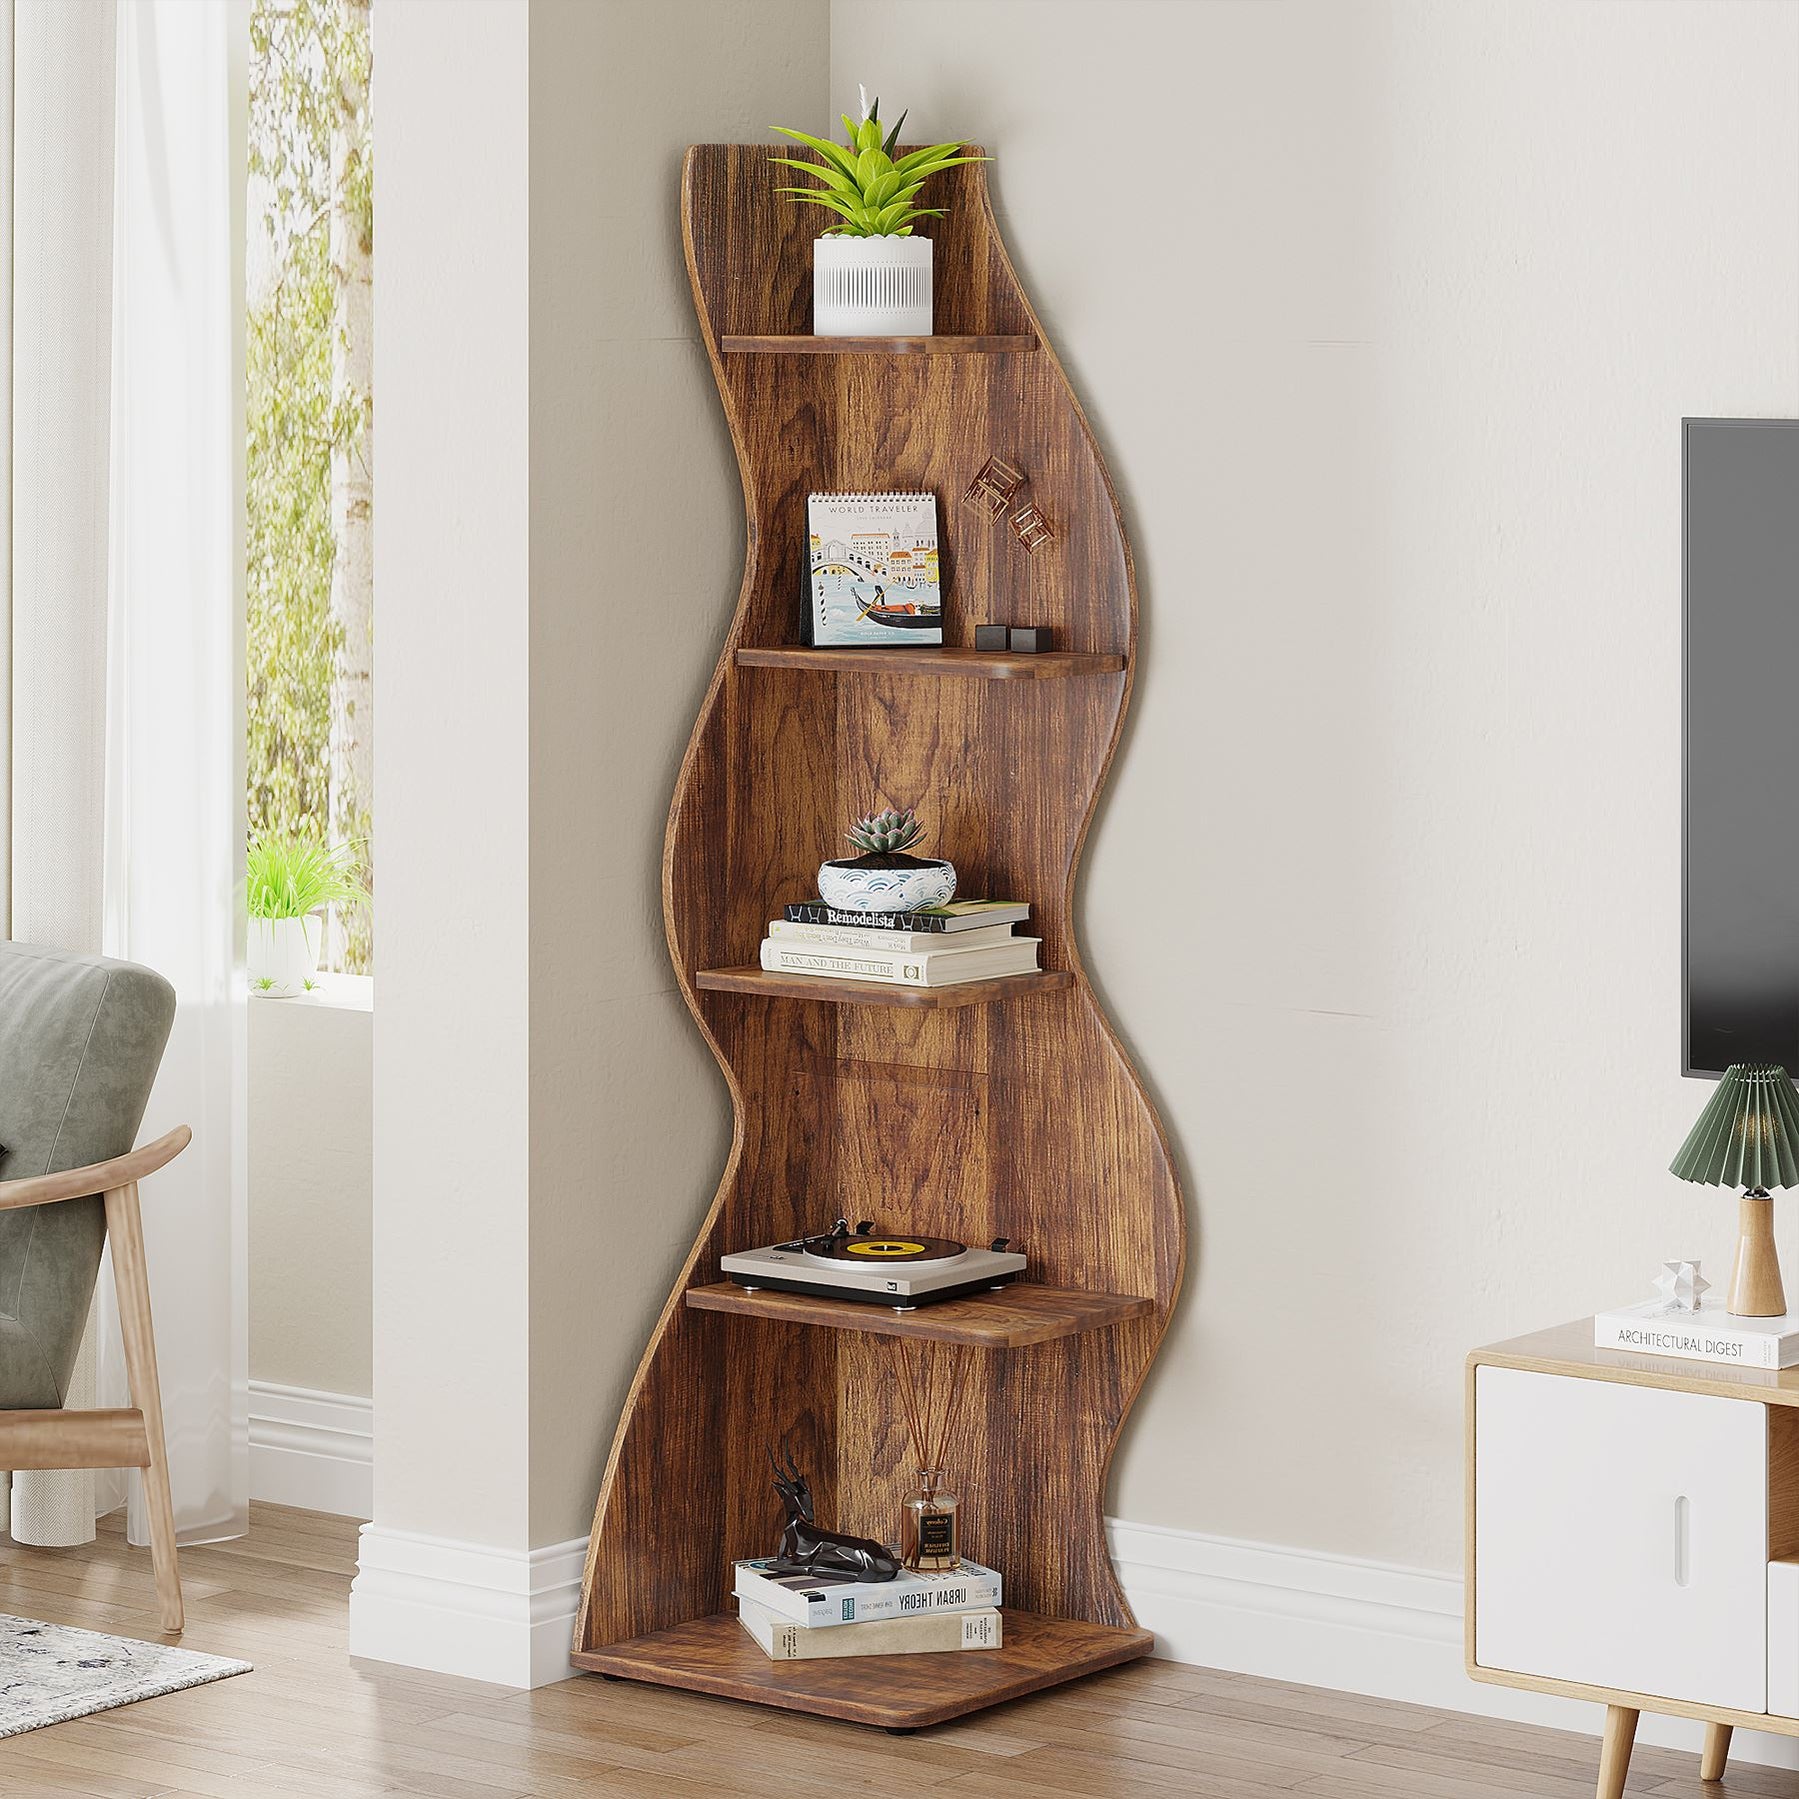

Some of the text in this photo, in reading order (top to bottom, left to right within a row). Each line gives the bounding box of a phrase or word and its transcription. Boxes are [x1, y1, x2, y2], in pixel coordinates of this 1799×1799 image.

[828, 505, 918, 514] WORLD TRAVELER
[826, 908, 896, 928] Remodelista
[781, 955, 802, 965] MAN
[806, 957, 827, 968] AND
[829, 959, 852, 970] THE
[854, 961, 894, 975] FUTURE
[1618, 1329, 1702, 1352] ARCHITECTURAL
[1705, 1340, 1744, 1358] DIGEST
